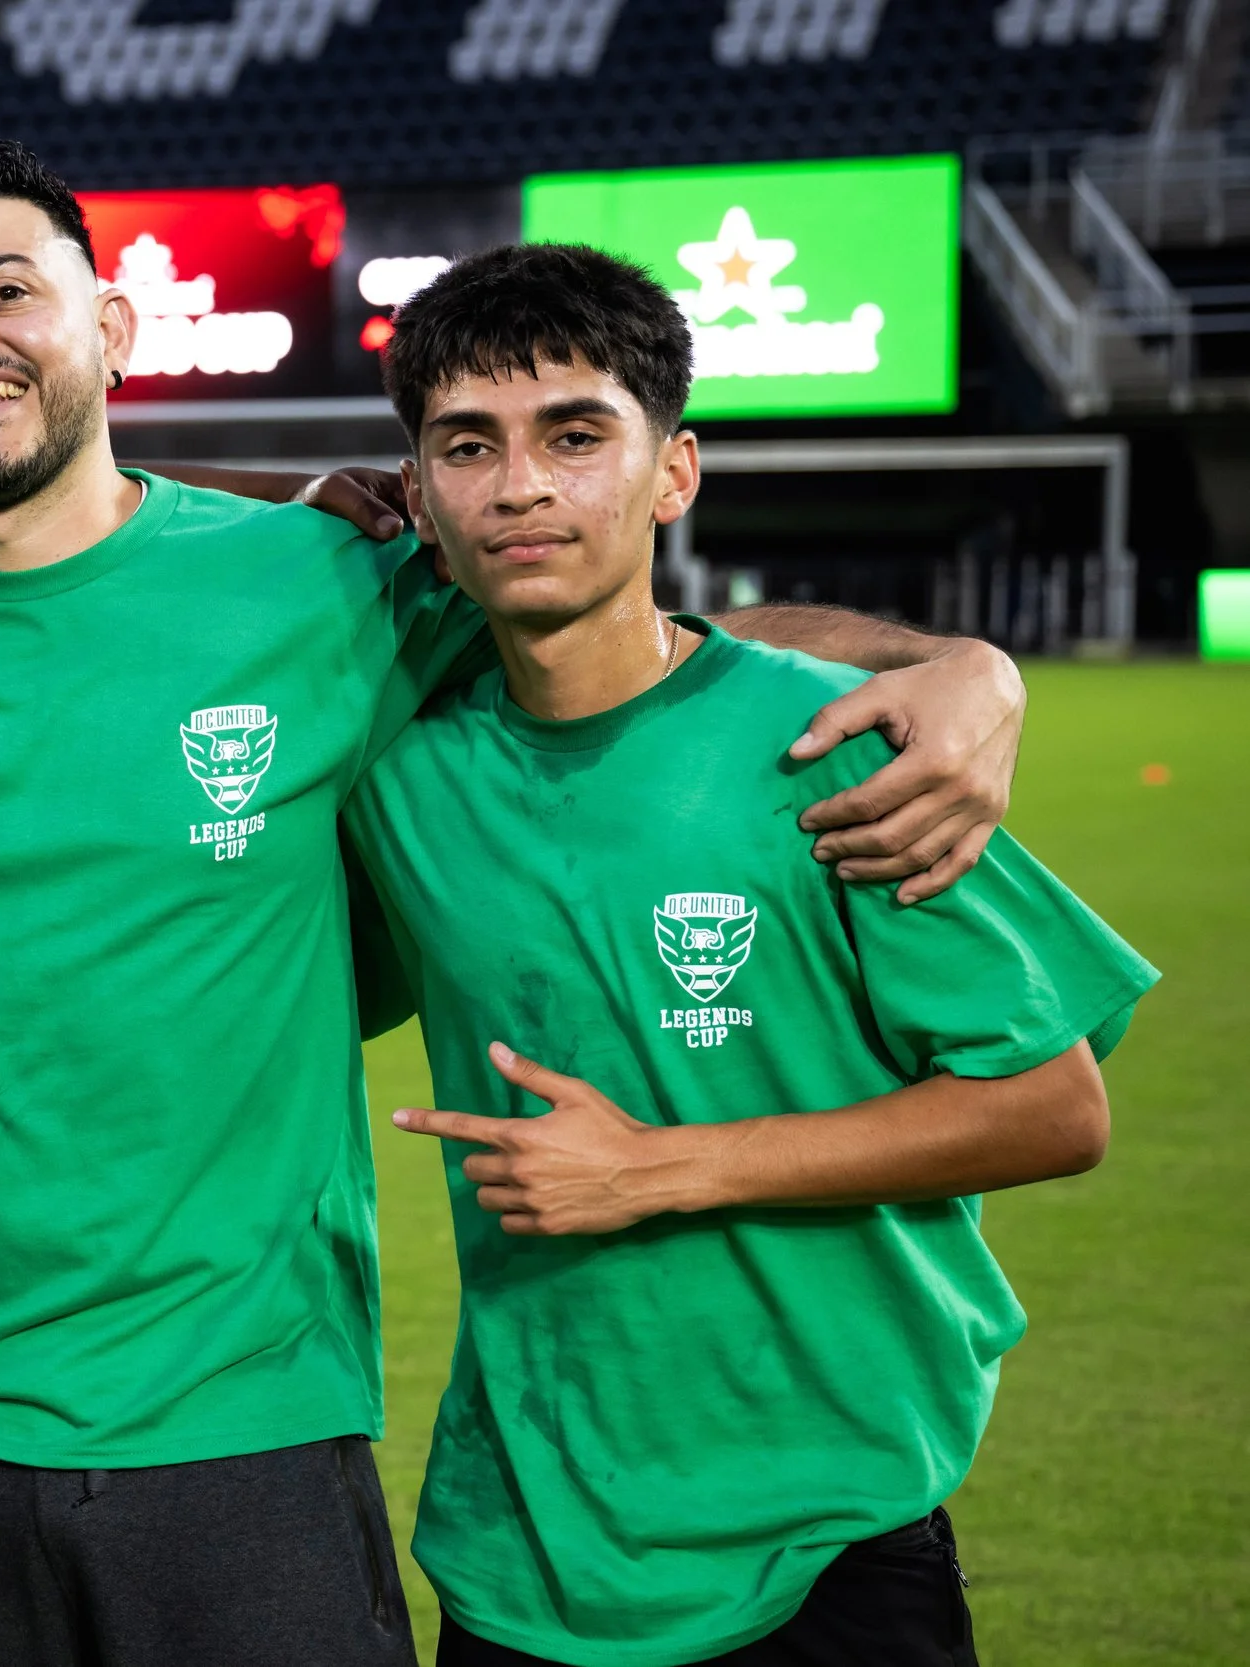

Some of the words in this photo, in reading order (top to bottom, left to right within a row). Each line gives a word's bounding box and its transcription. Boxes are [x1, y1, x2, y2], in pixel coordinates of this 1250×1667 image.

[189, 811, 266, 845] LEGENDS
[214, 837, 248, 862] CUP
[659, 1006, 753, 1029] LEGENDS
[685, 1026, 729, 1049] CUP
